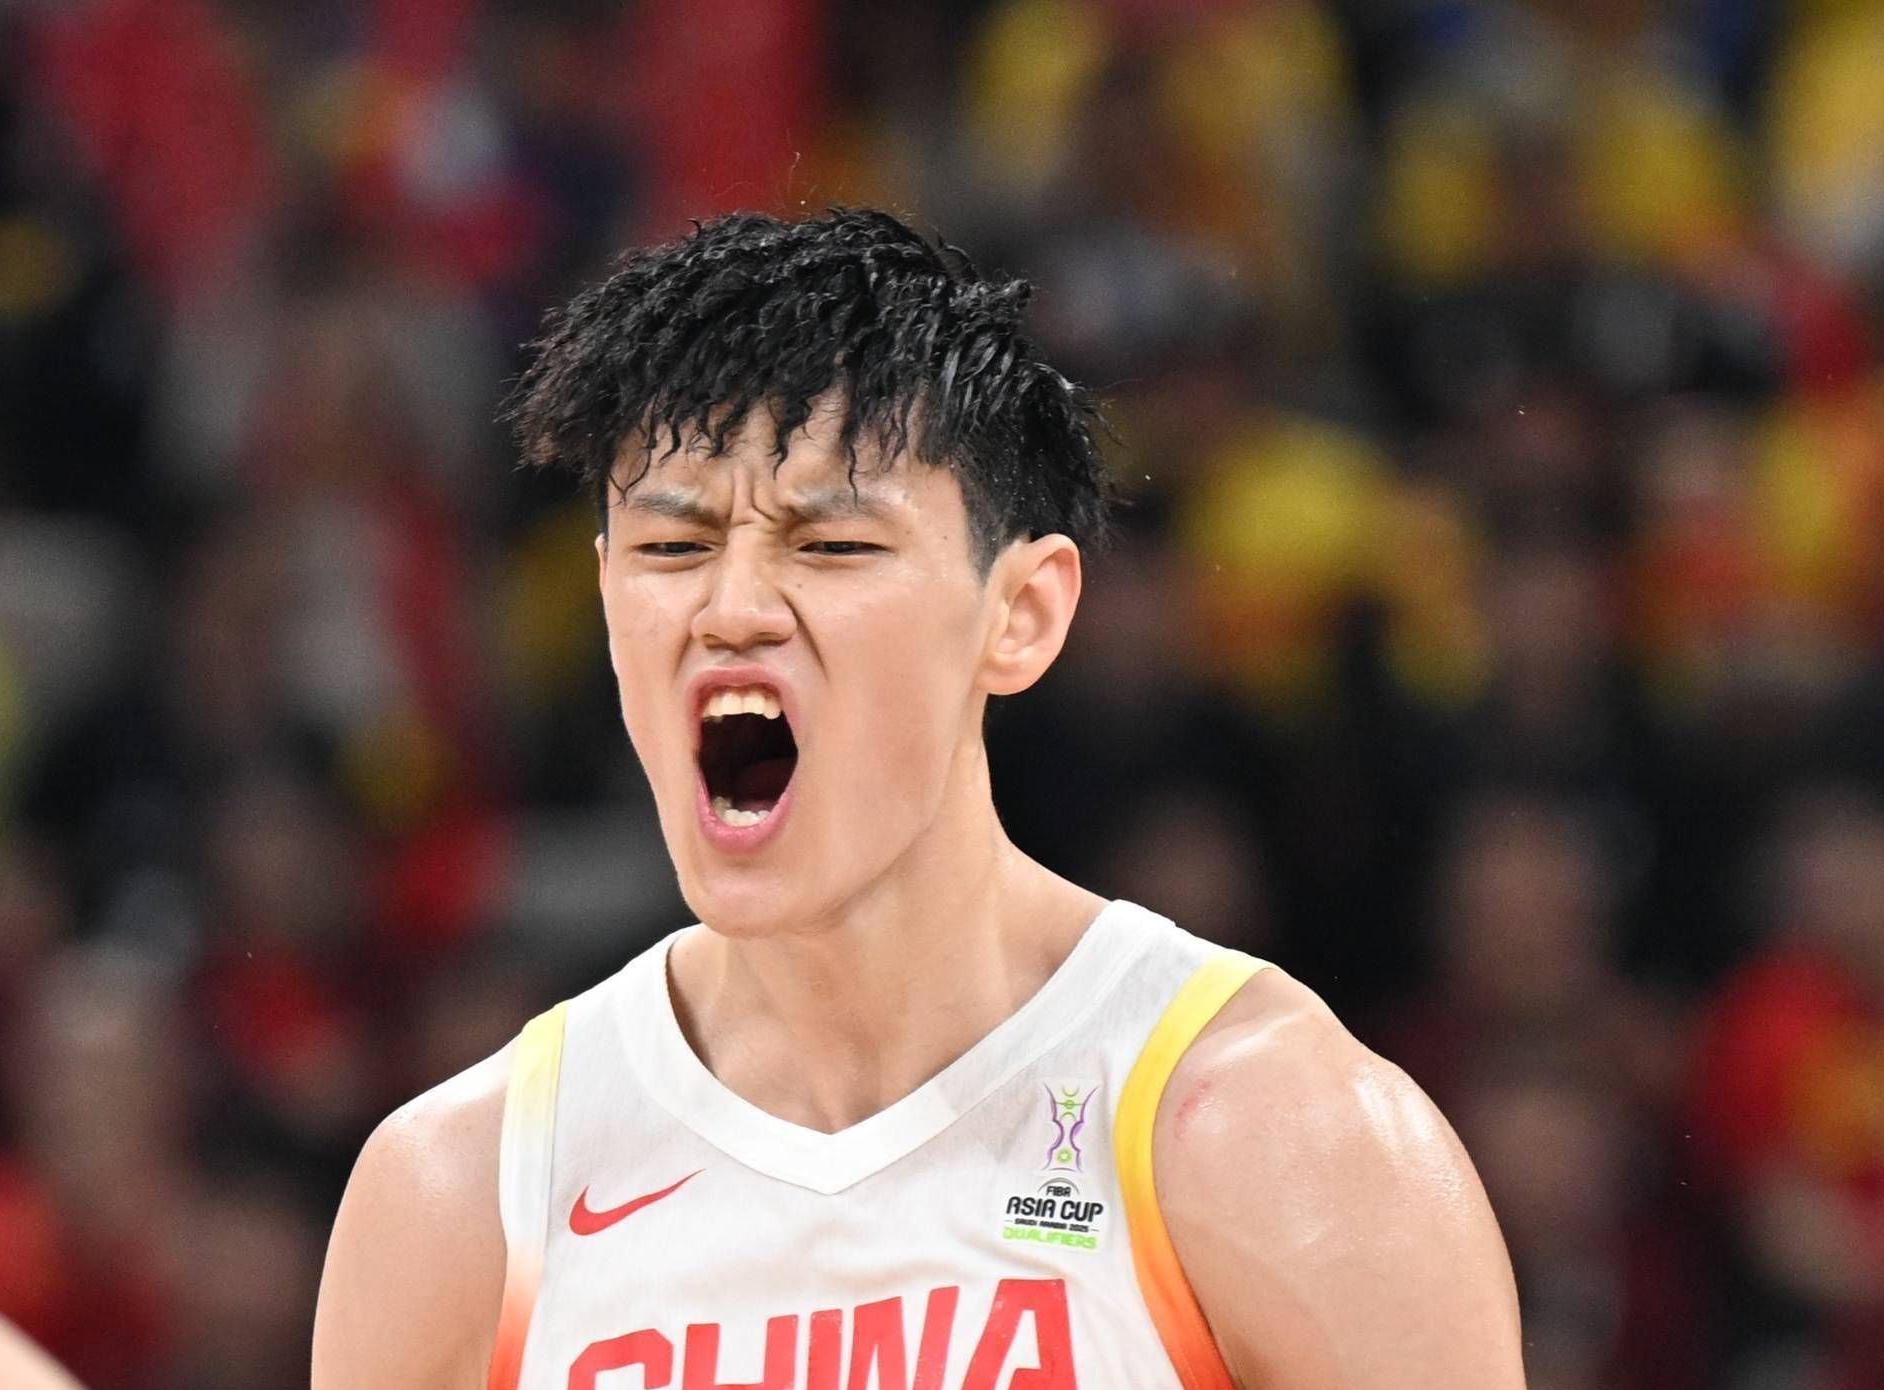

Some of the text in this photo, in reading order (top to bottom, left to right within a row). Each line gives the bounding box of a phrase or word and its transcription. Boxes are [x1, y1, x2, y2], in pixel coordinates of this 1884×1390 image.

[1045, 1185, 1071, 1197] FIBA
[1006, 1196, 1103, 1222] ASIA CUP
